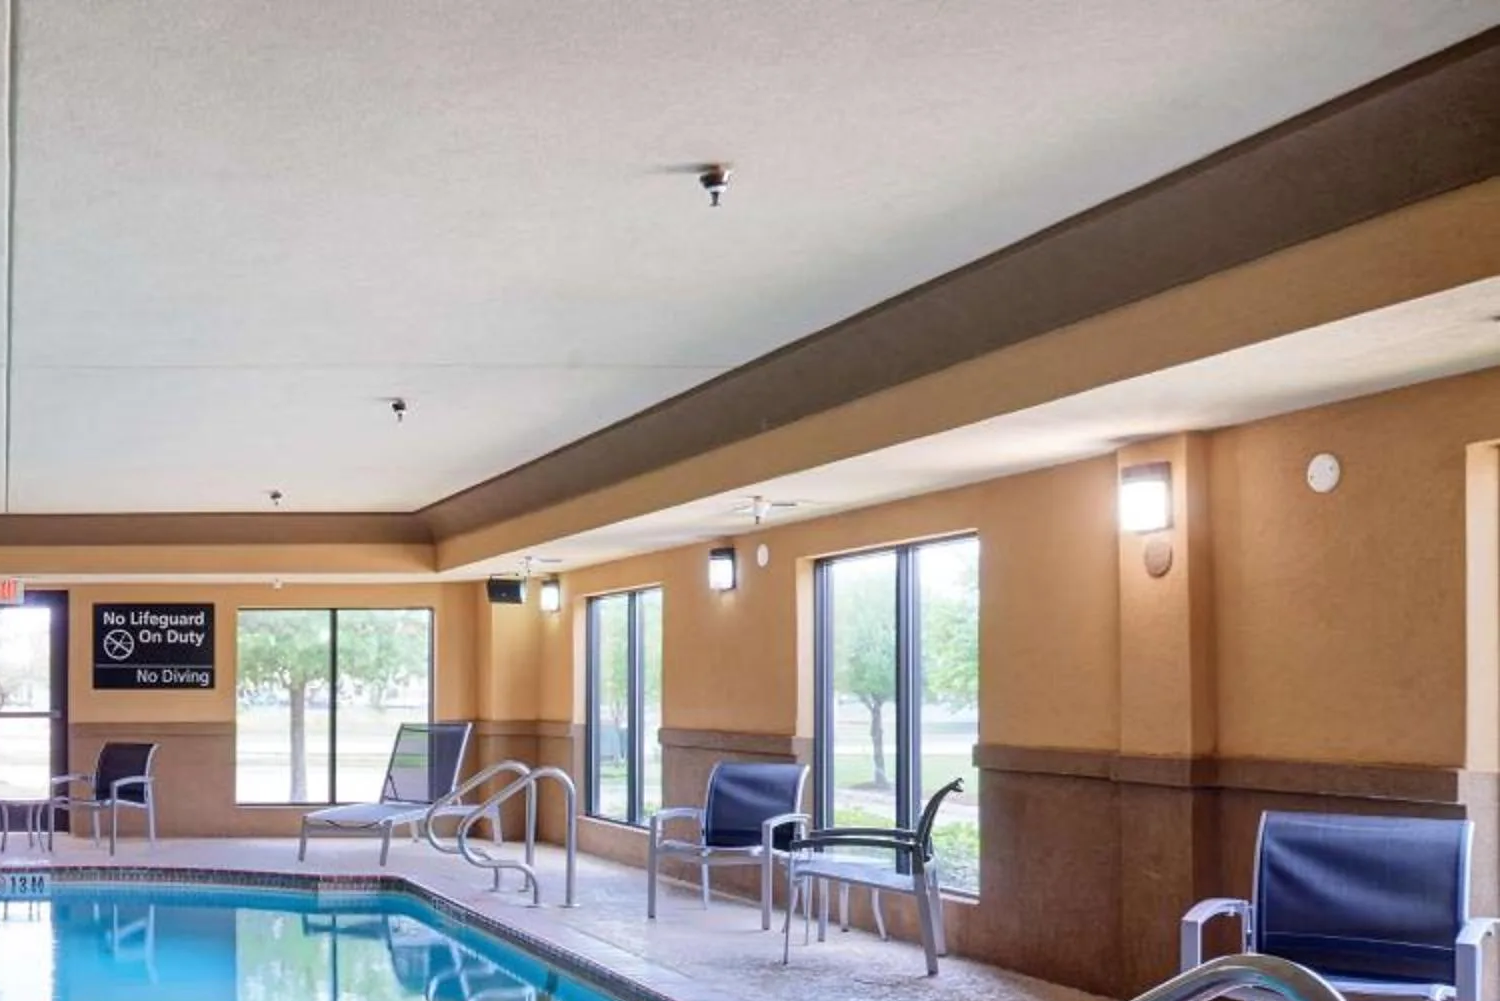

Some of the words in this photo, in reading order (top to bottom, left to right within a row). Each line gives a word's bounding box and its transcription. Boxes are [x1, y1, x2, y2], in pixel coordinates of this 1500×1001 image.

[103, 611, 125, 625] No
[130, 610, 205, 629] Lifeguard
[140, 629, 162, 643] On
[167, 629, 205, 647] Duty
[138, 669, 158, 683] No
[162, 669, 209, 687] Diving
